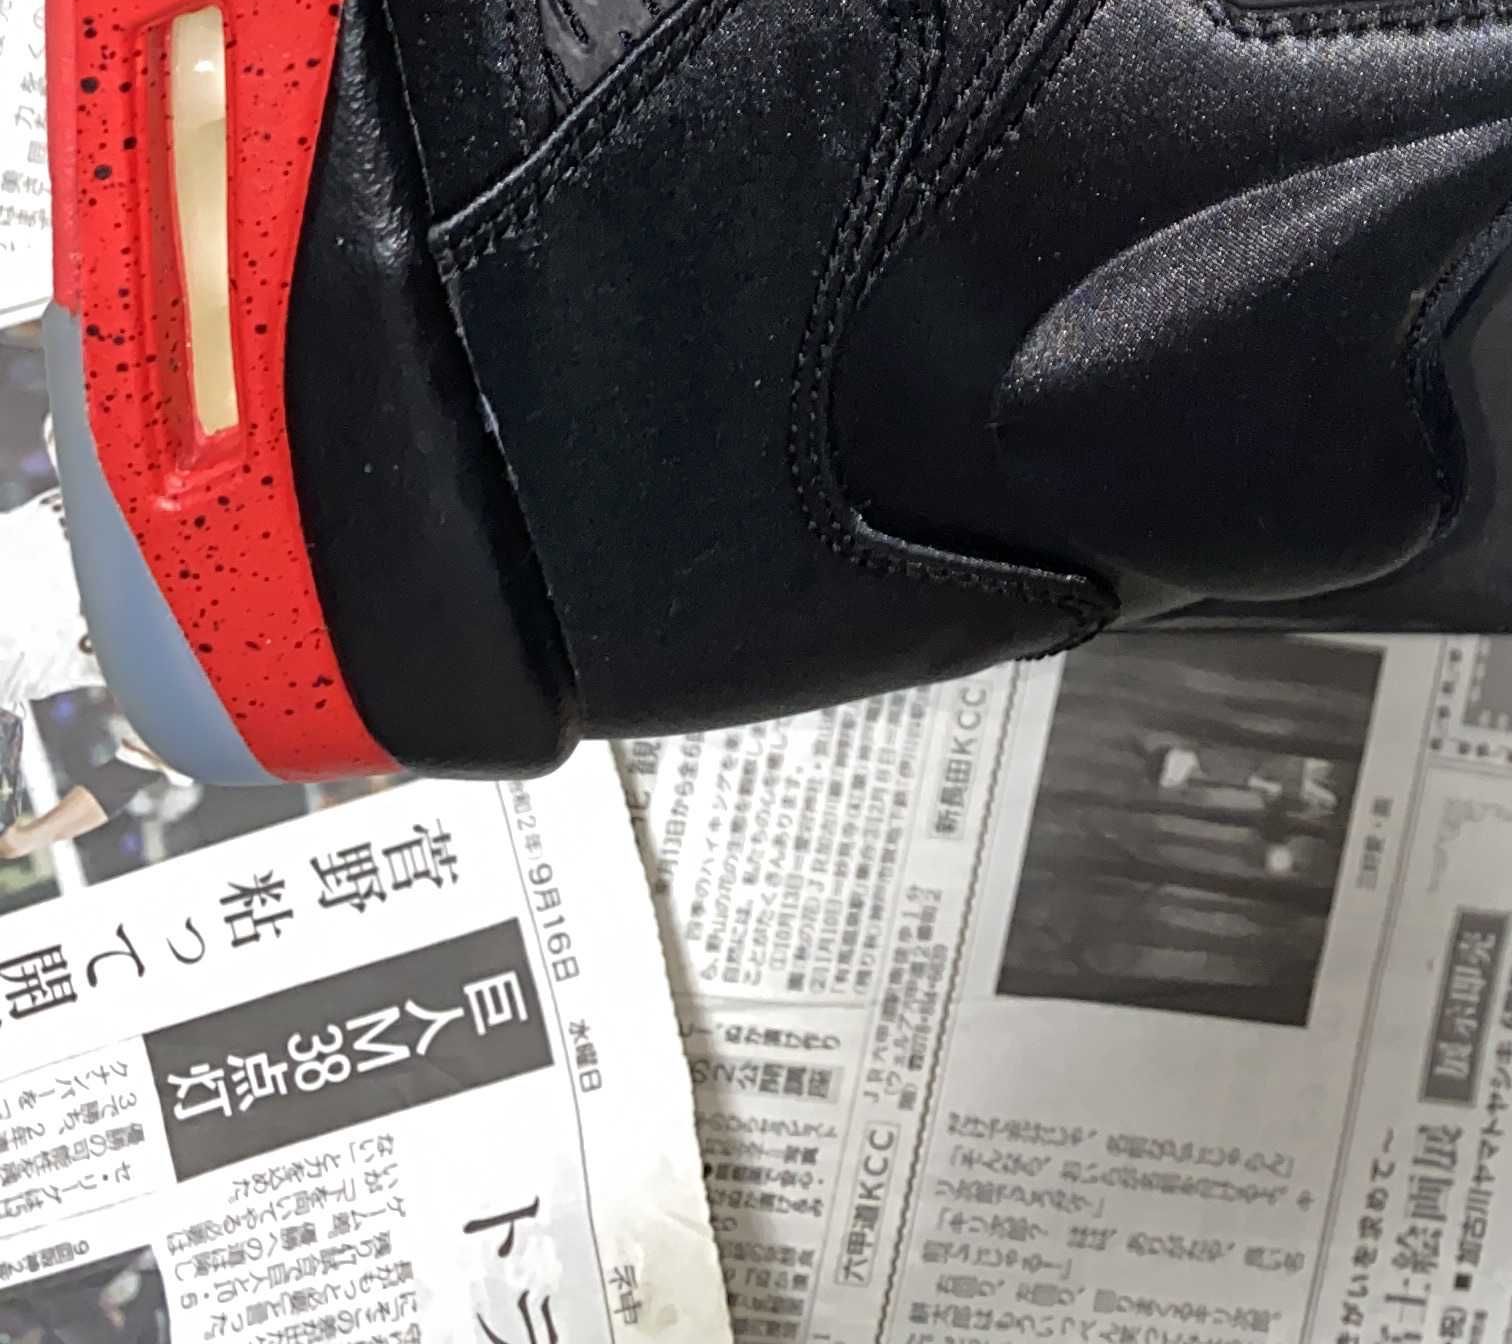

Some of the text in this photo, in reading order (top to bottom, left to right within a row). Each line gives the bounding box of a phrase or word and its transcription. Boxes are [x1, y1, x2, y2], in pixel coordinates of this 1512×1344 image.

[933, 687, 987, 836] 新長田KCC
[0, 823, 458, 1019] 菅野 粘って開
[528, 863, 580, 983] 9月16日
[560, 1019, 603, 1093] 水曜日
[169, 973, 526, 1118] 巨人M38点灯
[838, 1130, 896, 1286] 六甲道KCC
